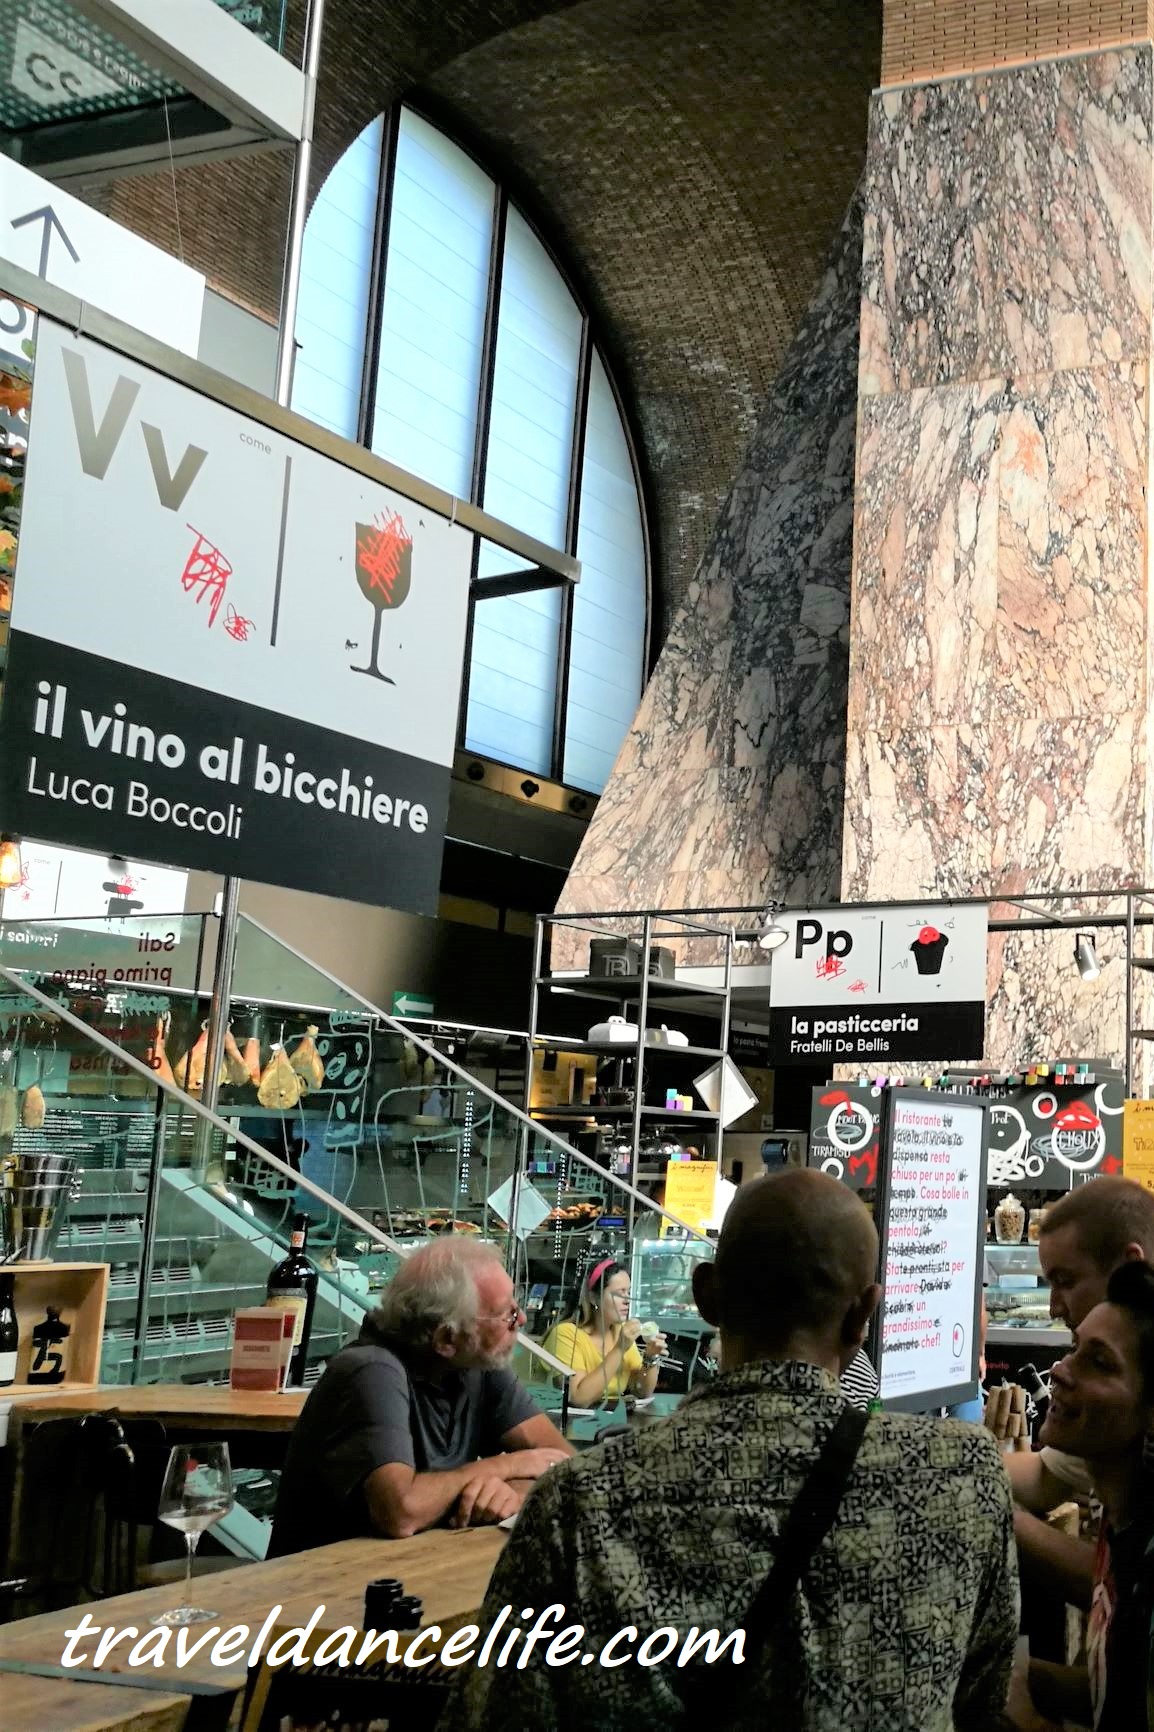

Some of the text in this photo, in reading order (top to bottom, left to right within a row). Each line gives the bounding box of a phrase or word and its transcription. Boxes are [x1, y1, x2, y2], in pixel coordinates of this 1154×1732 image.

[240, 432, 272, 454] come
[34, 680, 430, 834] il vino al bicchiere
[28, 756, 243, 841] Luca Boccoli
[795, 919, 853, 972] Pp
[791, 1013, 919, 1038] la pasticceria
[790, 1038, 890, 1053] Fratelli De Bellis
[902, 1110, 941, 1127] ristorante
[930, 1151, 950, 1163] resta
[891, 1166, 917, 1180] chiuso
[919, 1171, 932, 1184] per
[935, 1171, 944, 1180] un
[920, 1186, 940, 1200] Cosa
[942, 1186, 960, 1199] bolle
[962, 1187, 969, 1199] in
[951, 1262, 965, 1275] per
[885, 1280, 918, 1295] arrivare
[916, 1301, 926, 1312] un
[883, 1316, 933, 1339] grandissimo
[921, 1332, 941, 1348] chef!
